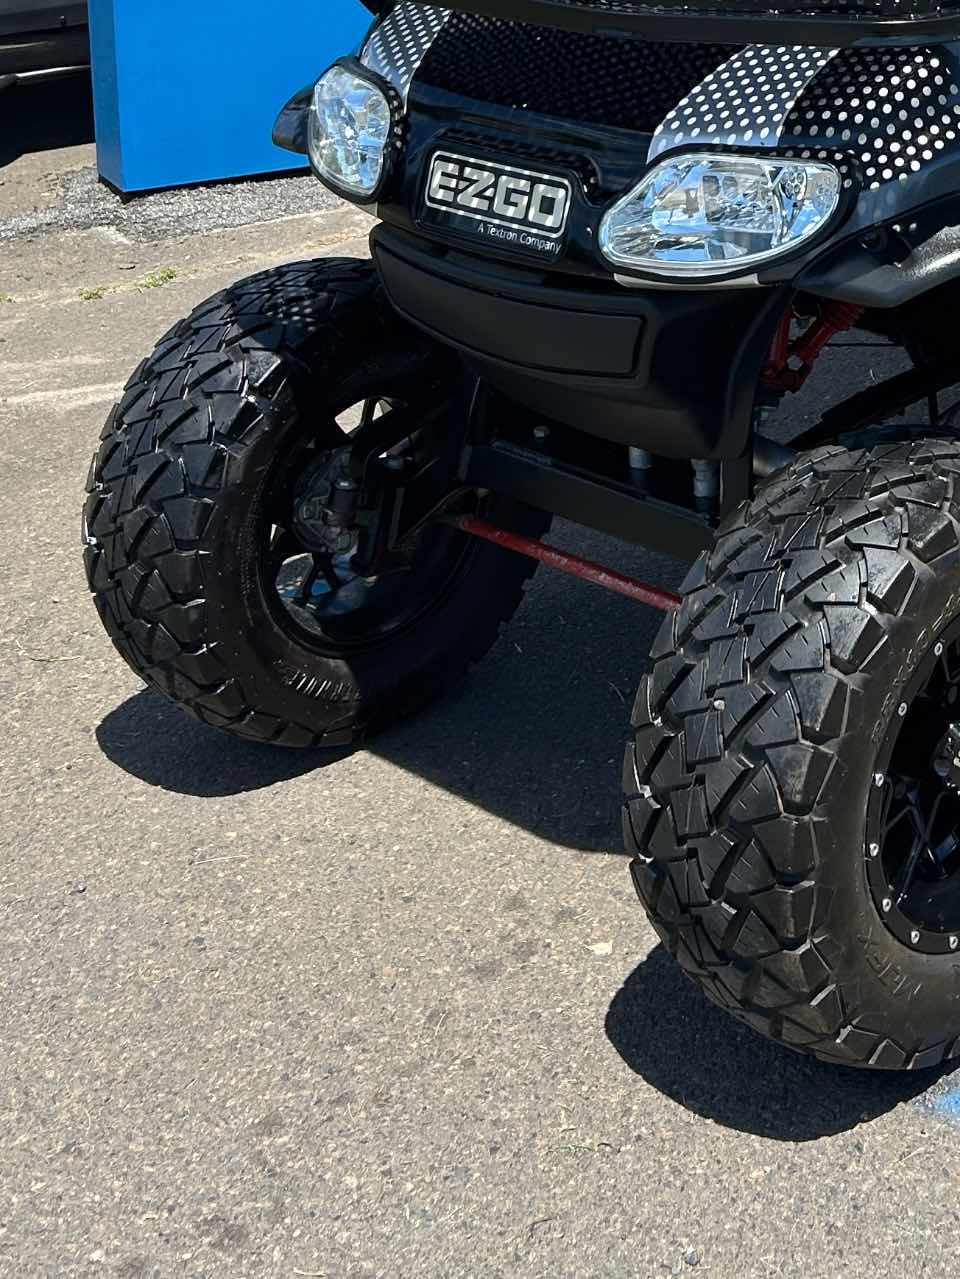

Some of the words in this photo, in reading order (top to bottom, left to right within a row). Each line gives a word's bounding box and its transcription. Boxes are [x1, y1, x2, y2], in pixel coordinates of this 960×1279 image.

[477, 224, 485, 233] A
[487, 224, 519, 242] Textron
[519, 232, 562, 255] Company
